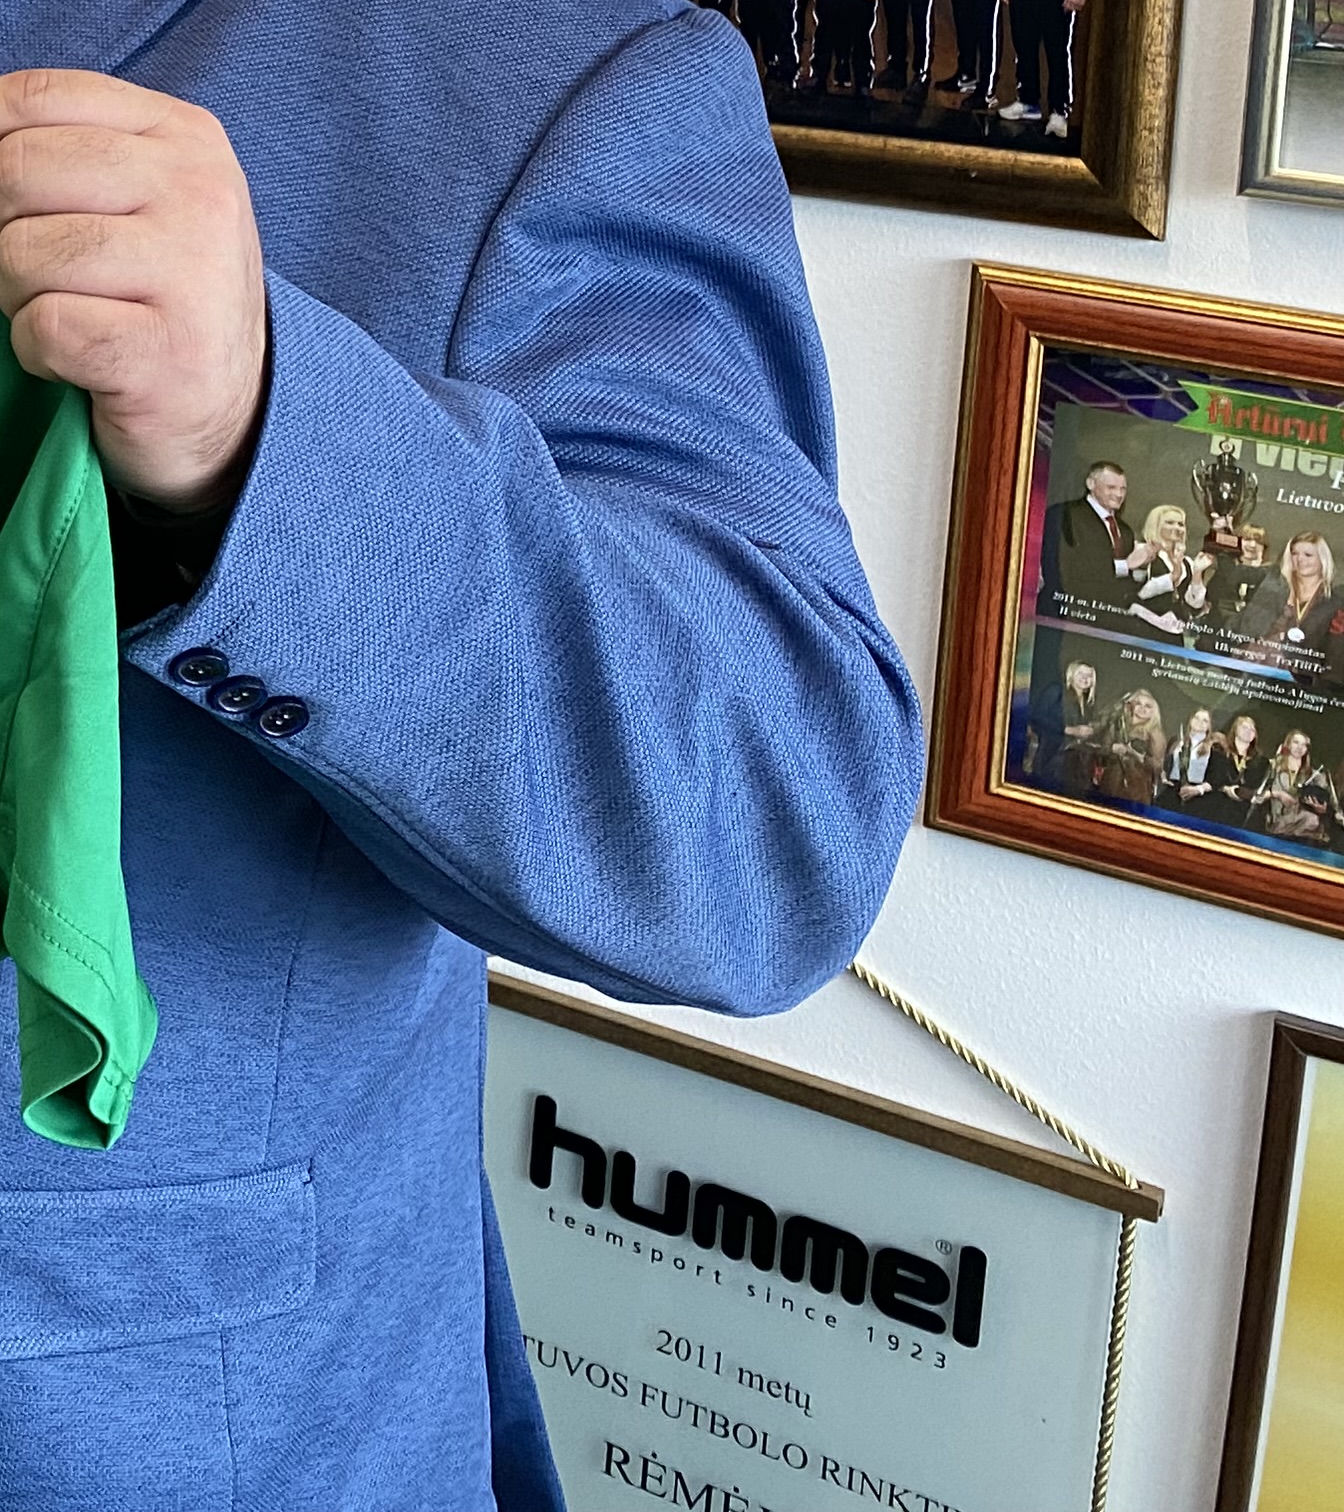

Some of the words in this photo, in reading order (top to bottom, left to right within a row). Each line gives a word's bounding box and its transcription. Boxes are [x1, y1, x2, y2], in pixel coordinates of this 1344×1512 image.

[1276, 488, 1344, 514] Lietuvo
[1053, 591, 1074, 604] 2011
[1092, 600, 1136, 617] Lietuvo
[1216, 628, 1225, 638] A
[1120, 648, 1143, 662] 2011
[1288, 687, 1297, 698] A
[528, 1094, 988, 1349] hummel
[548, 1206, 723, 1286] teamsport
[746, 1283, 837, 1329] since
[866, 1326, 948, 1370] 1923
[655, 1329, 724, 1376] 2011
[737, 1365, 815, 1419] metų
[639, 1382, 809, 1472] FUTBOLO
[602, 1438, 770, 1512] RĖMĖ
